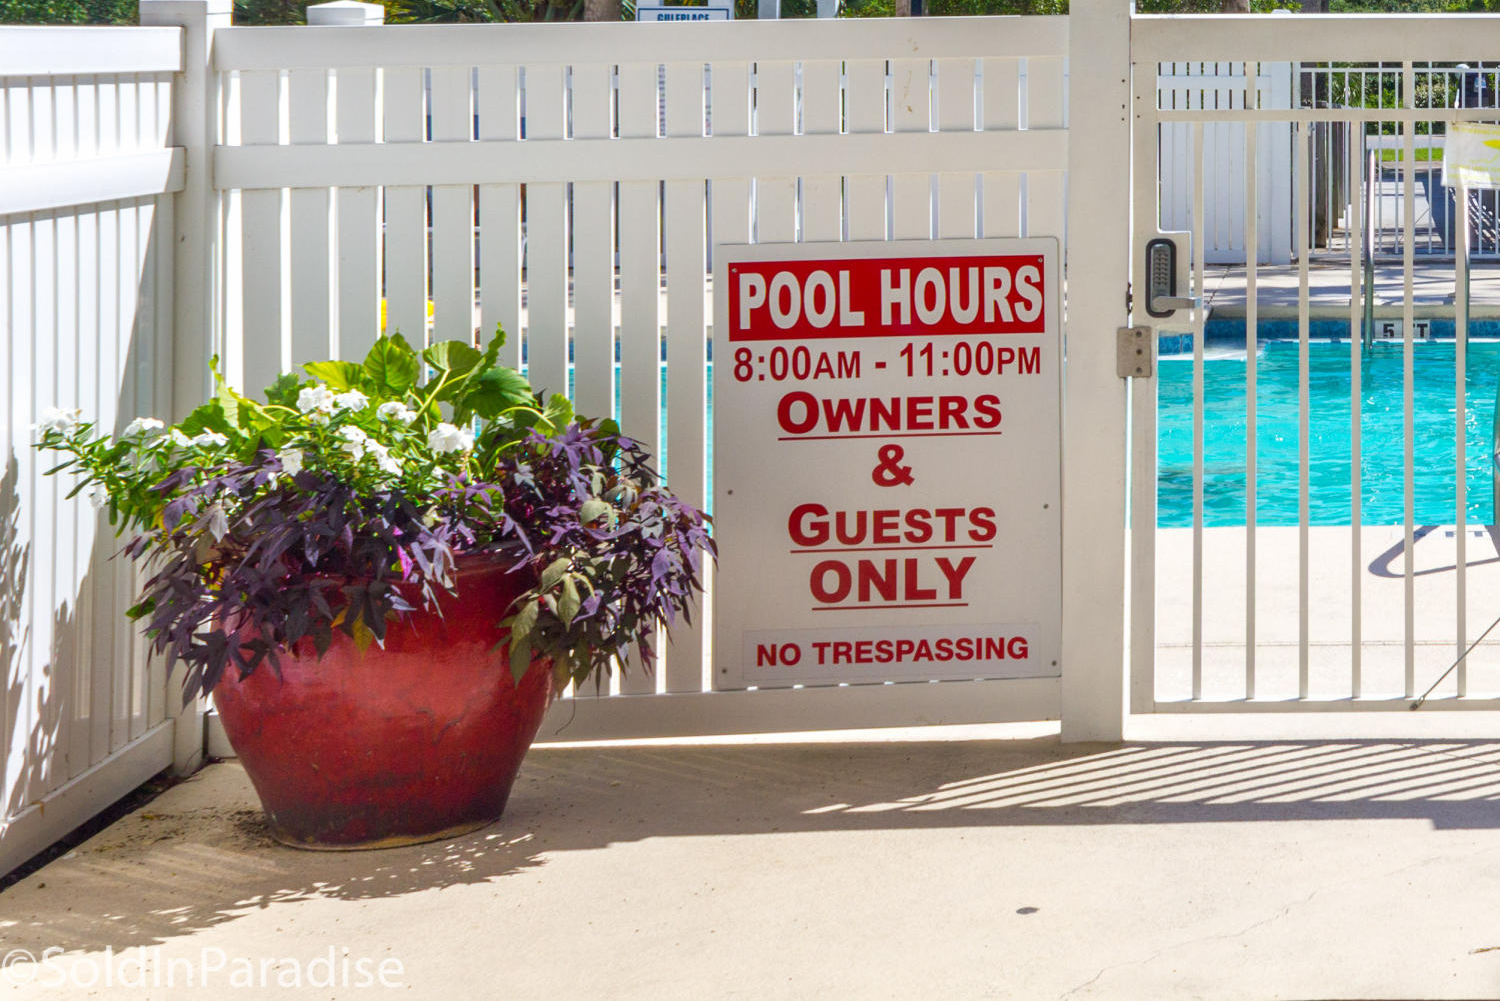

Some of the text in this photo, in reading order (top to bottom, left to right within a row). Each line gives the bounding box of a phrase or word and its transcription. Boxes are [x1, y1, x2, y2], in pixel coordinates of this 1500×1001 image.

[739, 265, 1043, 330] POOL HOURS
[1383, 323, 1395, 338] 5
[733, 345, 861, 383] 8:00AM
[899, 340, 1041, 378] 11:00PM
[776, 390, 1003, 435] OWNERS
[871, 443, 915, 488] &
[787, 502, 998, 548] GUESTS
[809, 556, 977, 605] ONLY
[756, 635, 1029, 668] NO TRESPASSING
